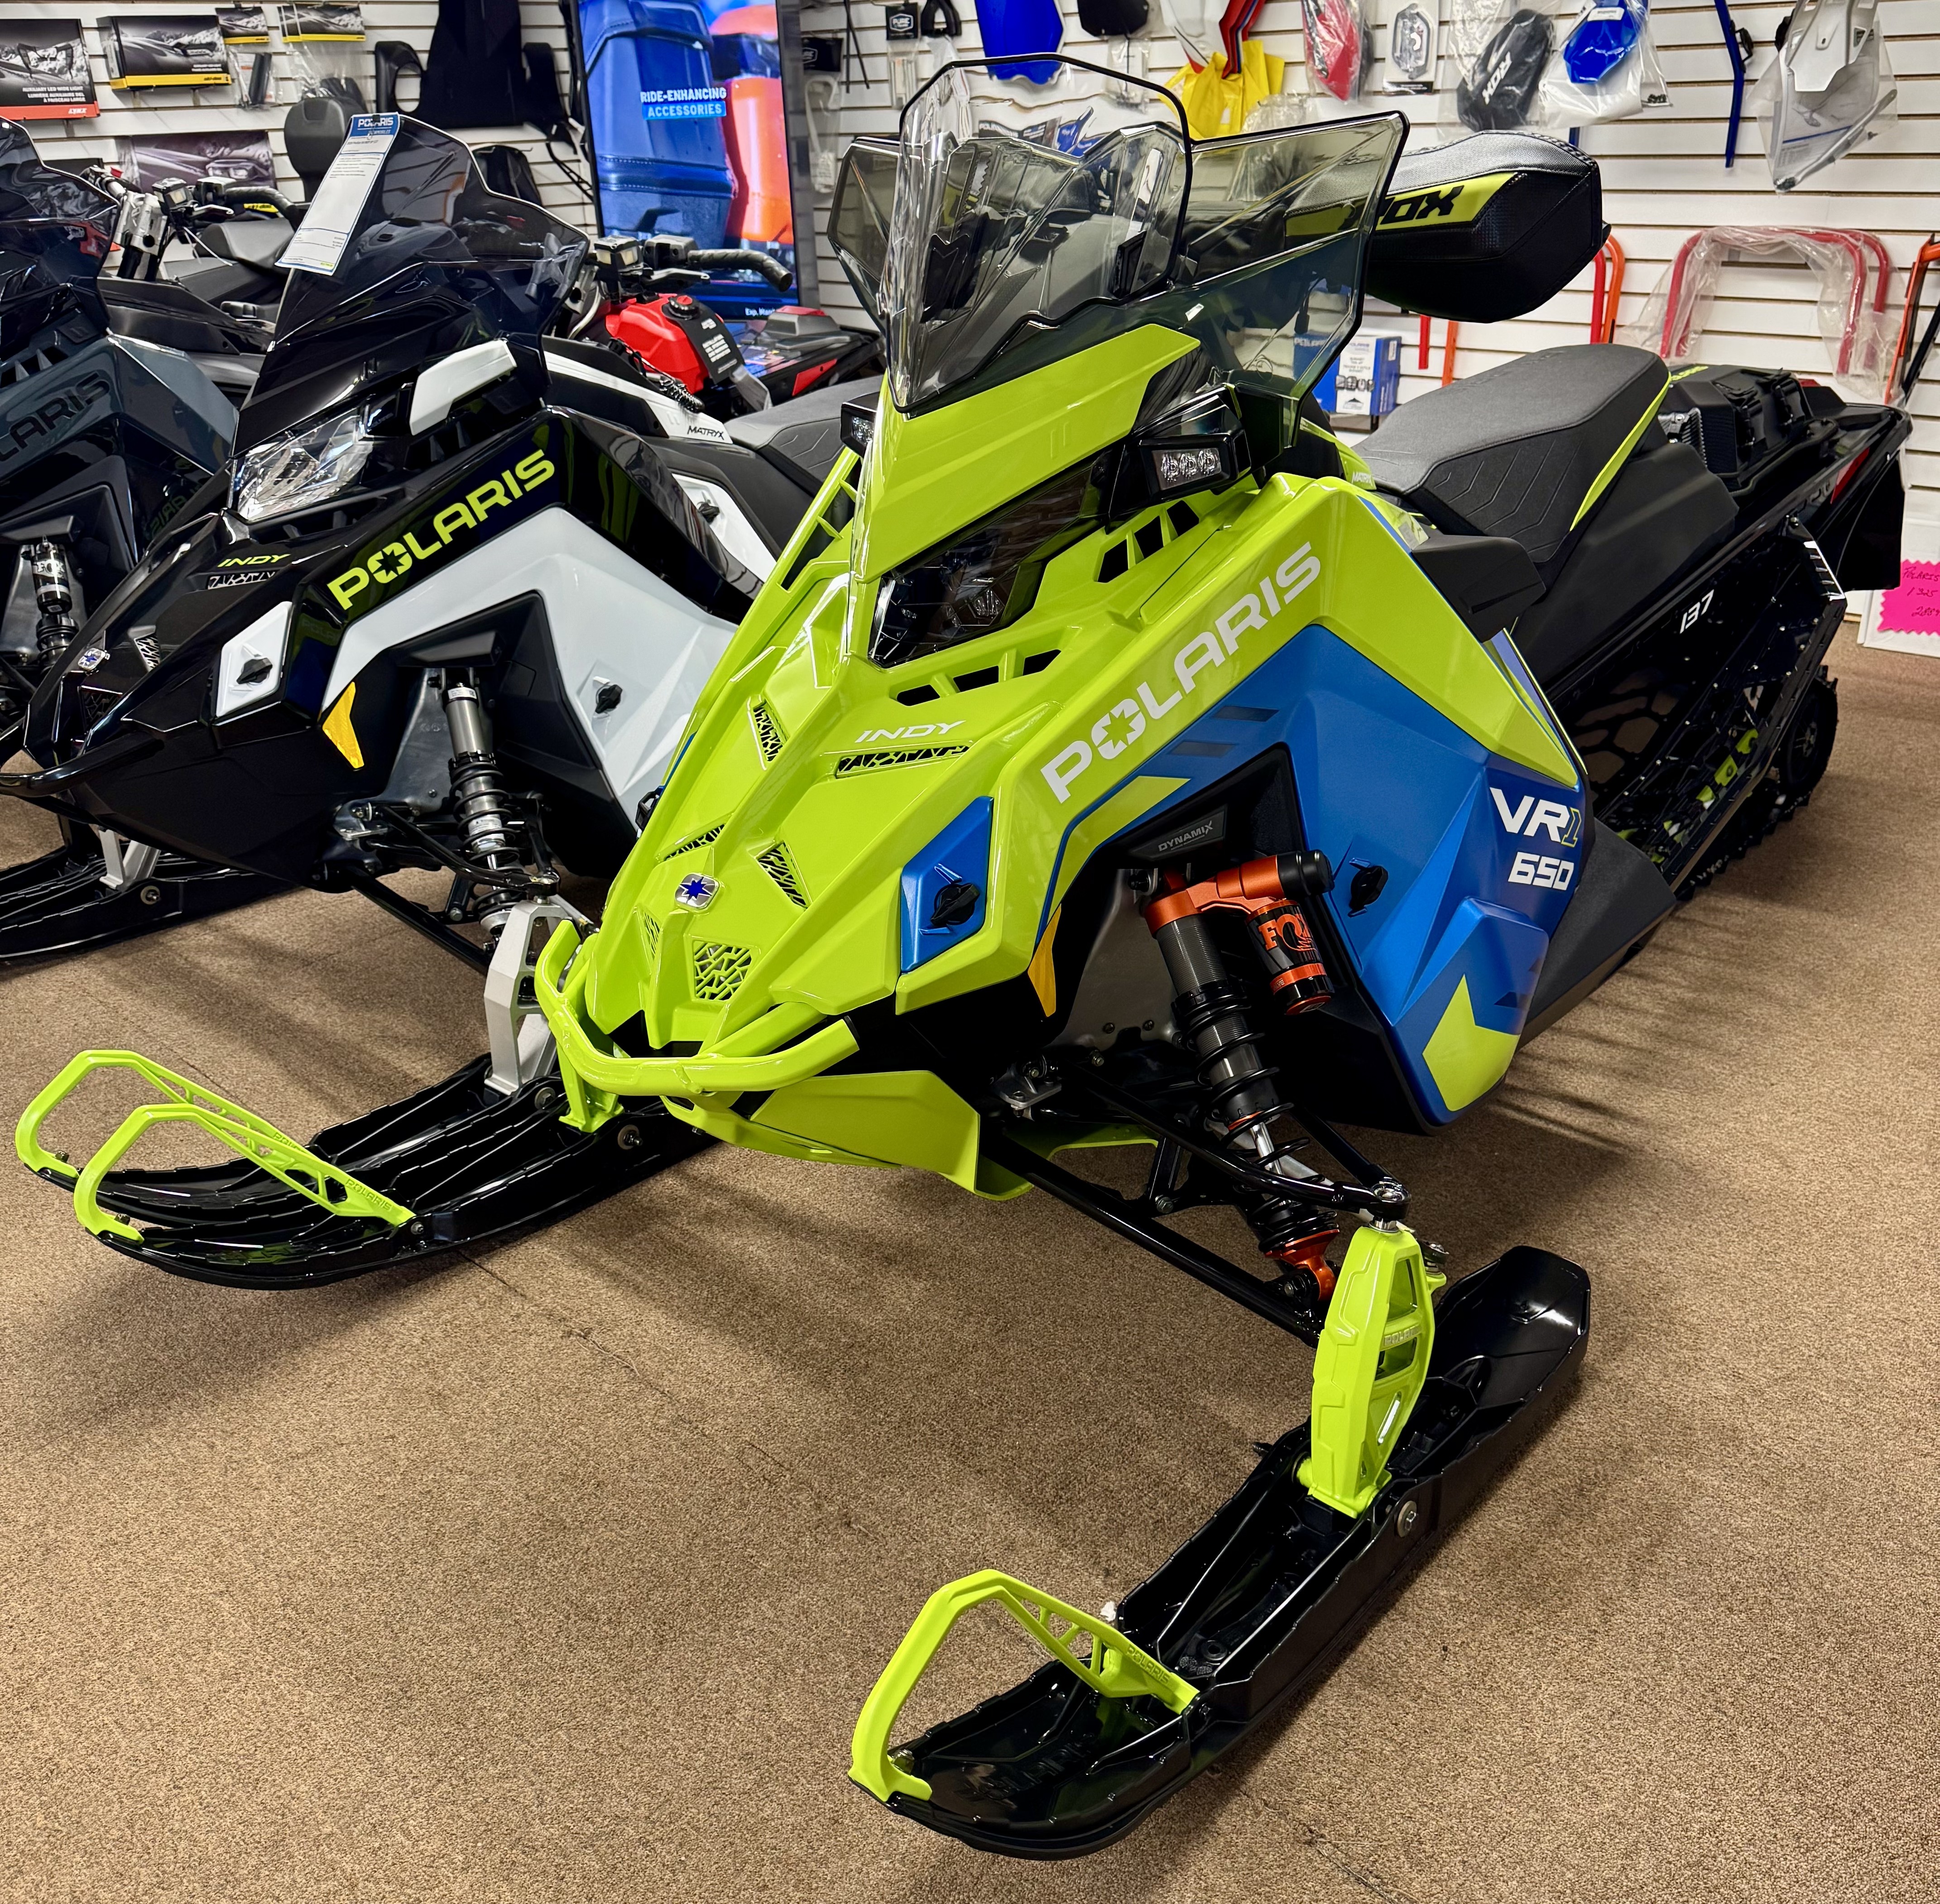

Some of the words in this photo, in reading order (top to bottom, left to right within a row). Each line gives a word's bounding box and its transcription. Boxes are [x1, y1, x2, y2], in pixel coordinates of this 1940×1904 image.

[1482, 51, 1512, 105] ROX
[640, 87, 727, 103] RIDE-ENHANCING
[648, 104, 722, 118] ACCESSORIES
[358, 117, 394, 127] PORIS
[687, 425, 725, 440] MATRYX
[327, 449, 555, 611] POLARIS
[217, 553, 291, 567] INDY
[1680, 589, 1714, 634] 137
[1041, 541, 1321, 804] POLARIS
[855, 720, 966, 743] INDY
[1489, 787, 1582, 847] VR1
[1158, 820, 1213, 851] DYNAMIX
[1508, 851, 1575, 890] 650
[345, 1178, 393, 1212] POLARIS
[1384, 1324, 1420, 1346] POLA
[1126, 1644, 1171, 1684] POLARIS
